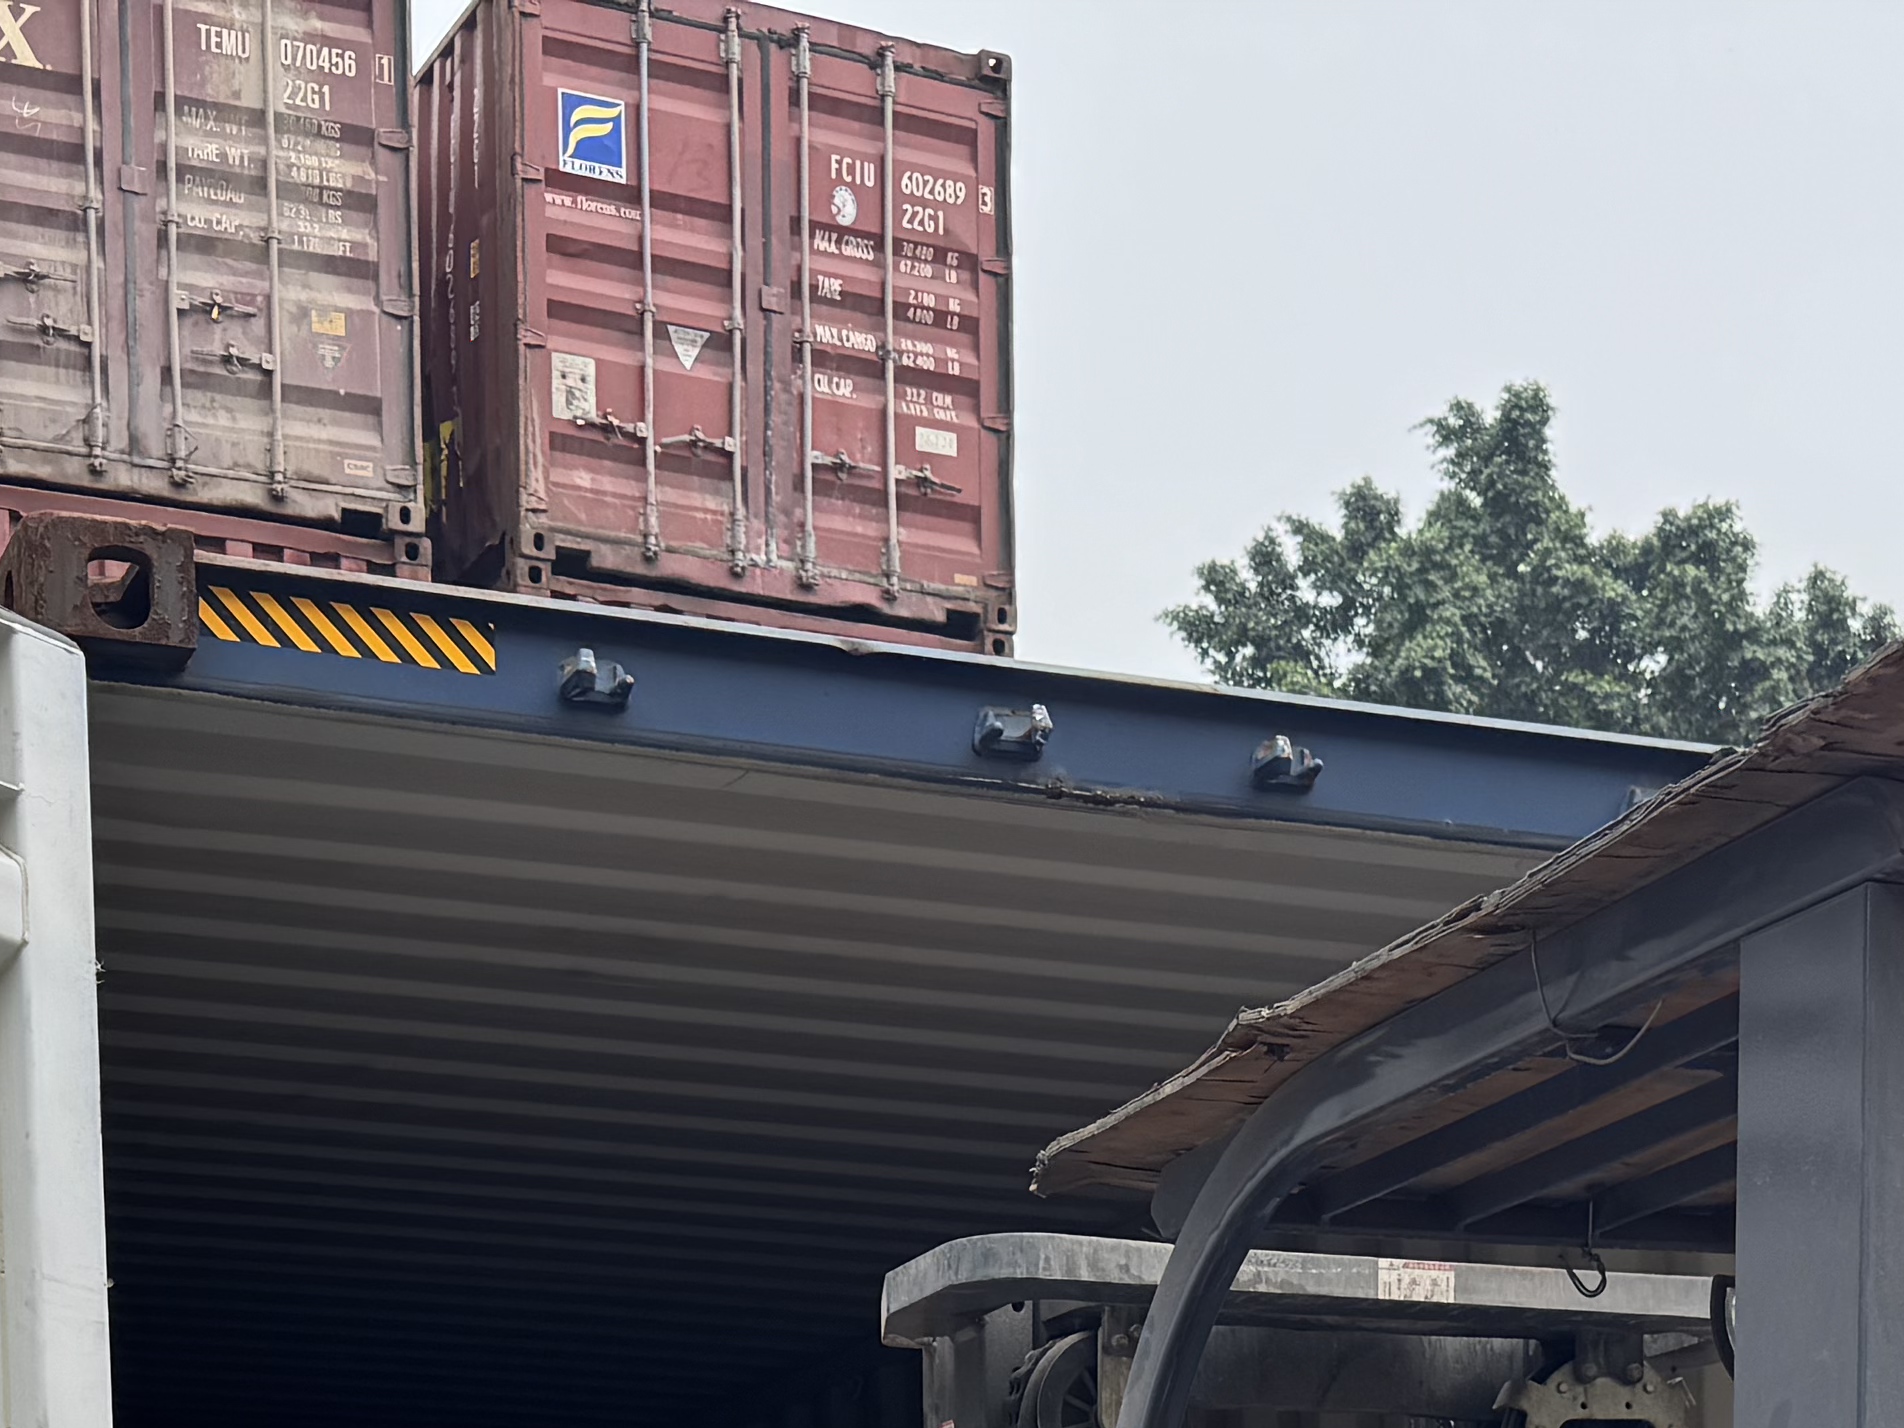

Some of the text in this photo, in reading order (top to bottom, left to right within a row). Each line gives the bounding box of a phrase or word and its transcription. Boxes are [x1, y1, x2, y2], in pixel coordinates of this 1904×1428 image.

[197, 23, 250, 58] TEMU
[280, 38, 357, 77] 070456
[283, 78, 331, 111] 22G1
[561, 158, 624, 180] FLORENS
[831, 154, 875, 187] FCIU
[901, 170, 967, 205] 602689
[902, 203, 944, 236] 22G1
